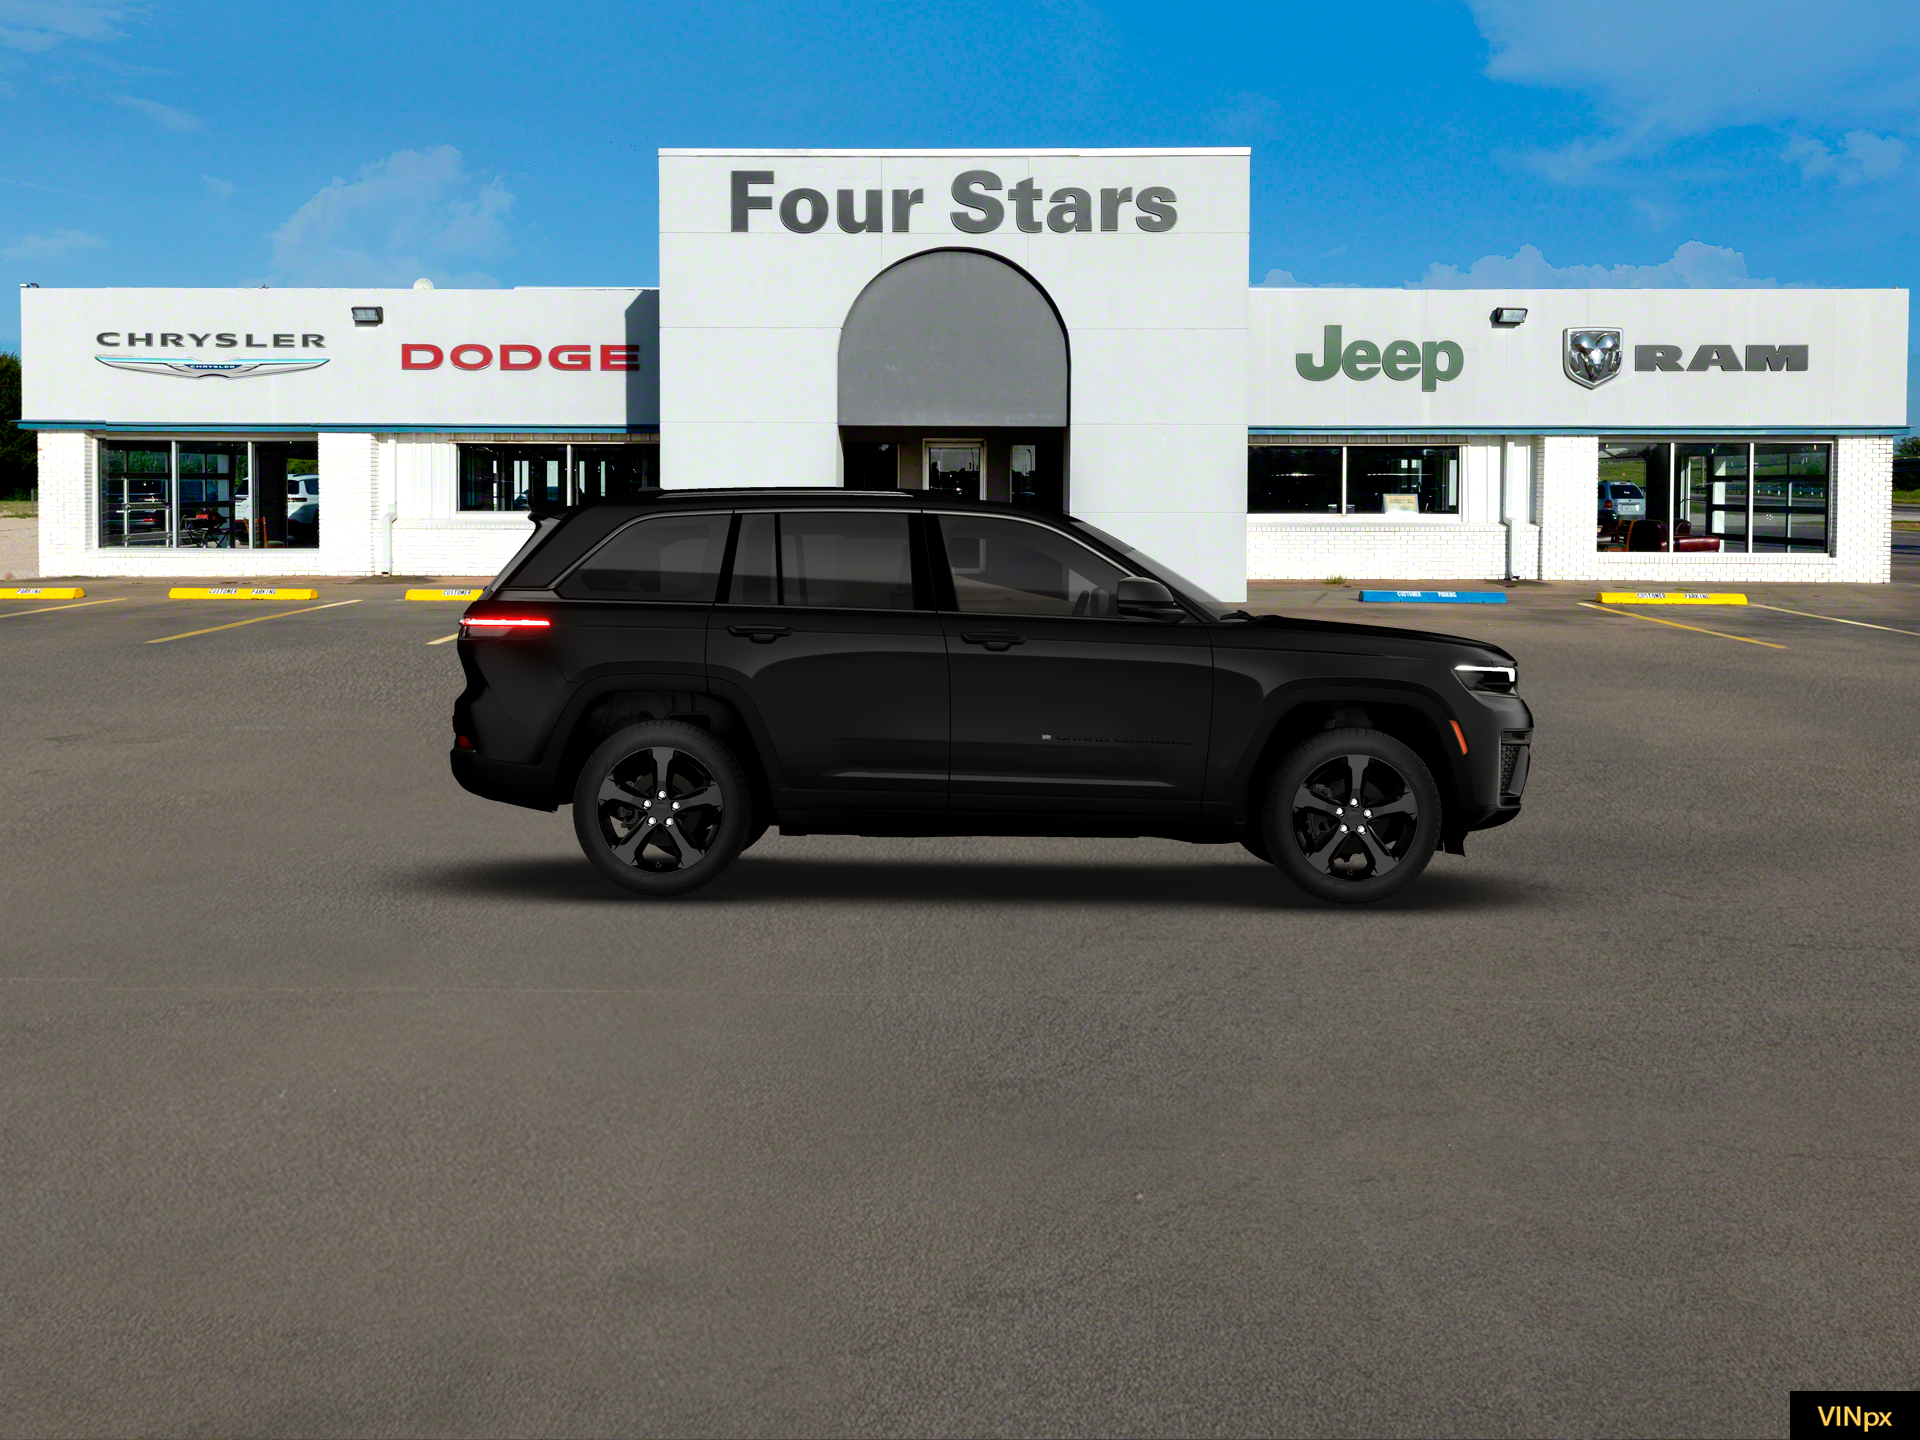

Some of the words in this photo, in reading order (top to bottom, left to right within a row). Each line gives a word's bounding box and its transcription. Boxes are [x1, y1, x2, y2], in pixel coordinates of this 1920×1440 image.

[730, 170, 924, 233] Four
[949, 169, 1178, 233] Stars
[96, 331, 326, 348] CHRYSLER
[401, 343, 640, 371] DODGE
[1295, 324, 1464, 392] Jeep
[1634, 344, 1809, 372] RAM
[1056, 735, 1110, 743] GRAND
[1114, 737, 1197, 746] CHEROKEE
